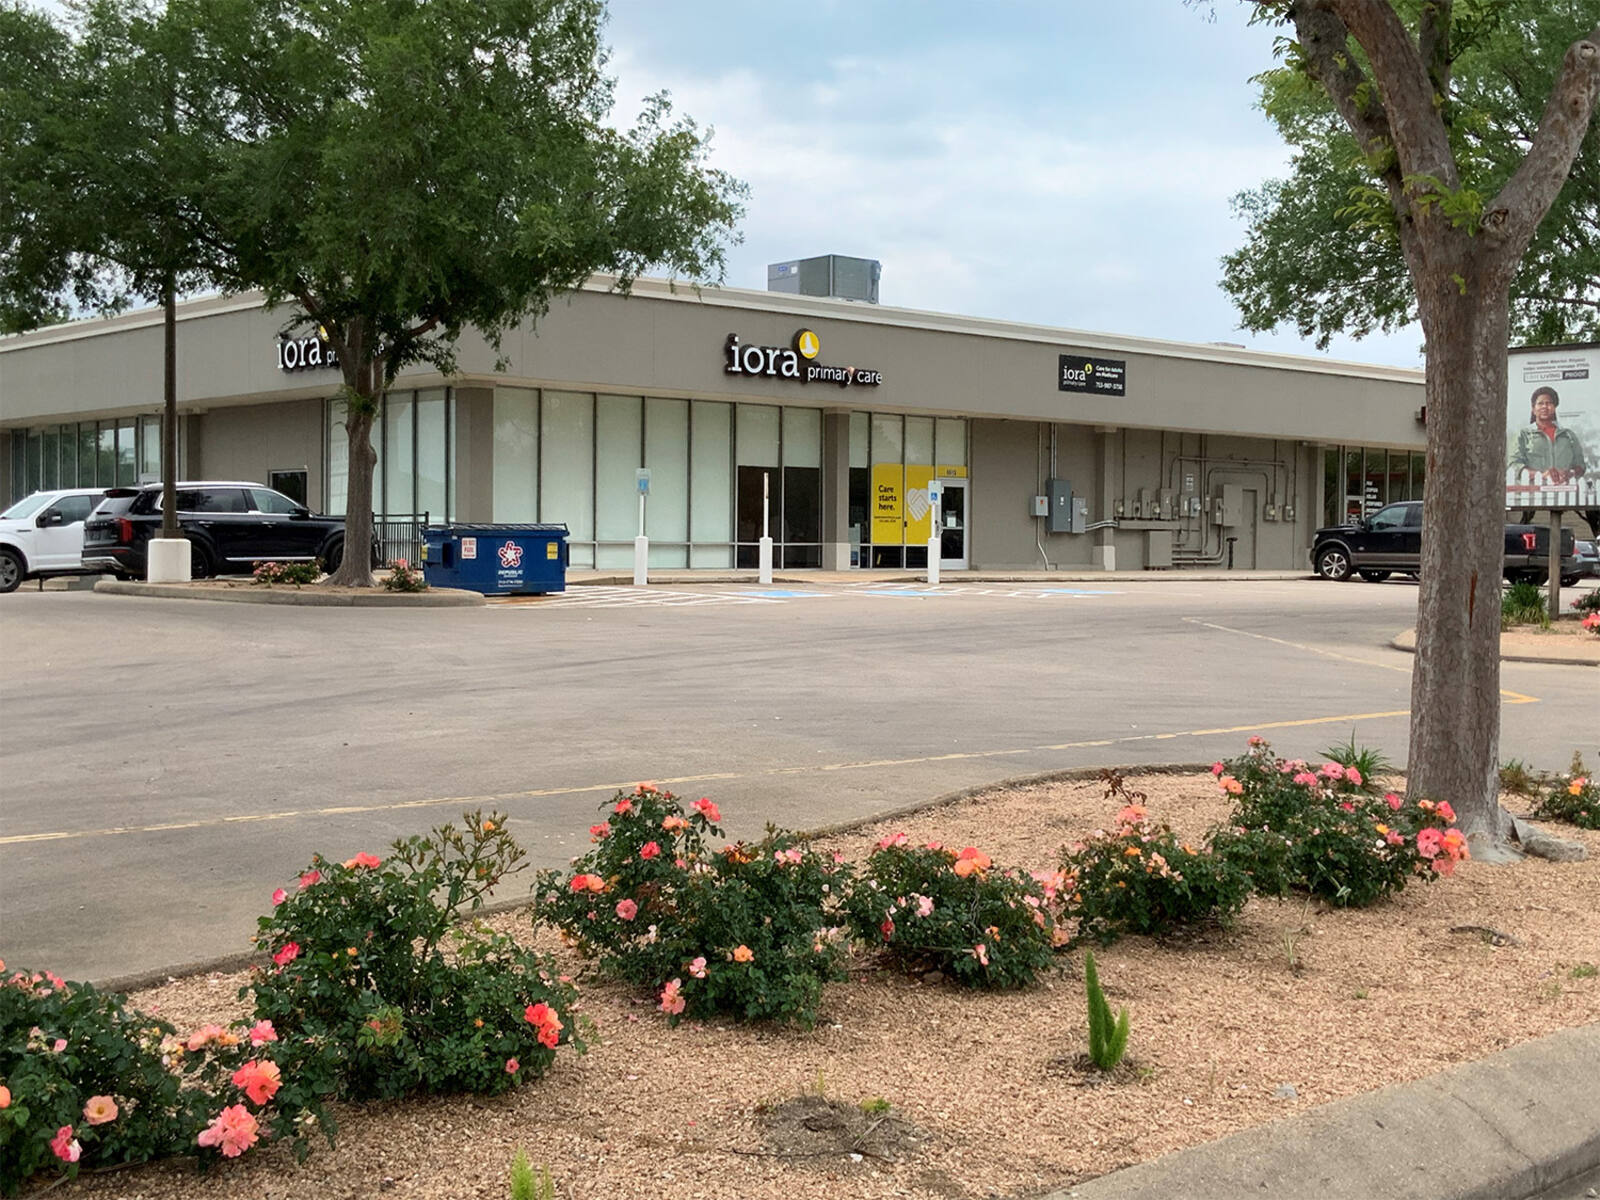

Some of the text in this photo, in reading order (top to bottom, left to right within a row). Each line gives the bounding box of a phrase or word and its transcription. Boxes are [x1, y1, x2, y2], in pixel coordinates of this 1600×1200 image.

[276, 336, 322, 369] iora
[727, 335, 801, 378] iora
[807, 365, 883, 385] primary care
[1063, 365, 1086, 381] iora
[878, 484, 894, 493] Care
[878, 494, 897, 502] starts
[878, 502, 896, 511] here.
